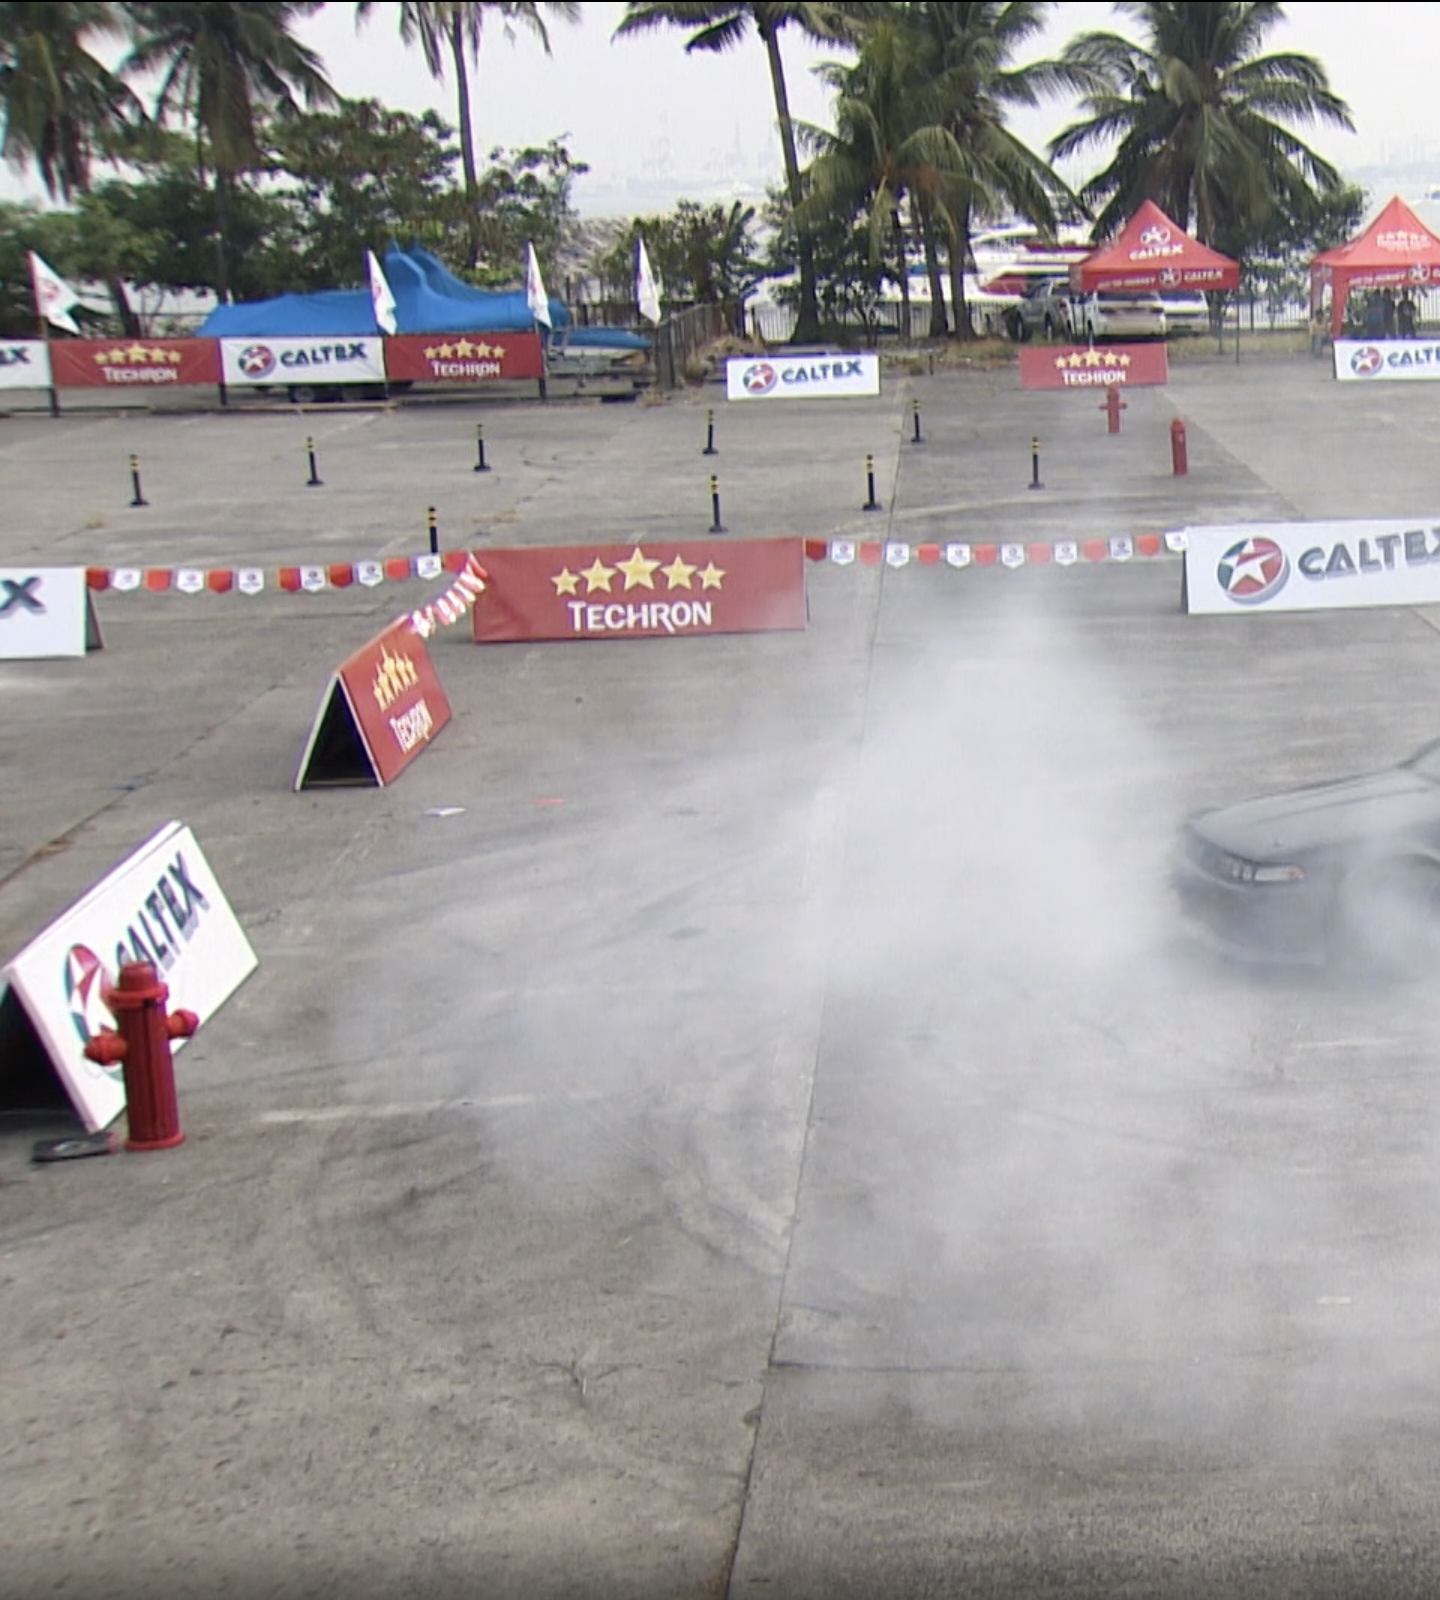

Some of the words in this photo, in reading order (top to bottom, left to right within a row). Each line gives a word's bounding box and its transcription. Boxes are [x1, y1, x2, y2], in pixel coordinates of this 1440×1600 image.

[1129, 244, 1184, 261] CALTEX
[280, 342, 368, 369] CALTEX
[102, 366, 178, 383] TECHRON
[432, 360, 501, 377] TECHRON
[781, 360, 863, 385] CALTEX
[1062, 369, 1127, 386] TECHRON
[567, 601, 712, 633] TECHRON
[389, 699, 433, 753] TECHRON
[116, 851, 210, 974] ALTEX
